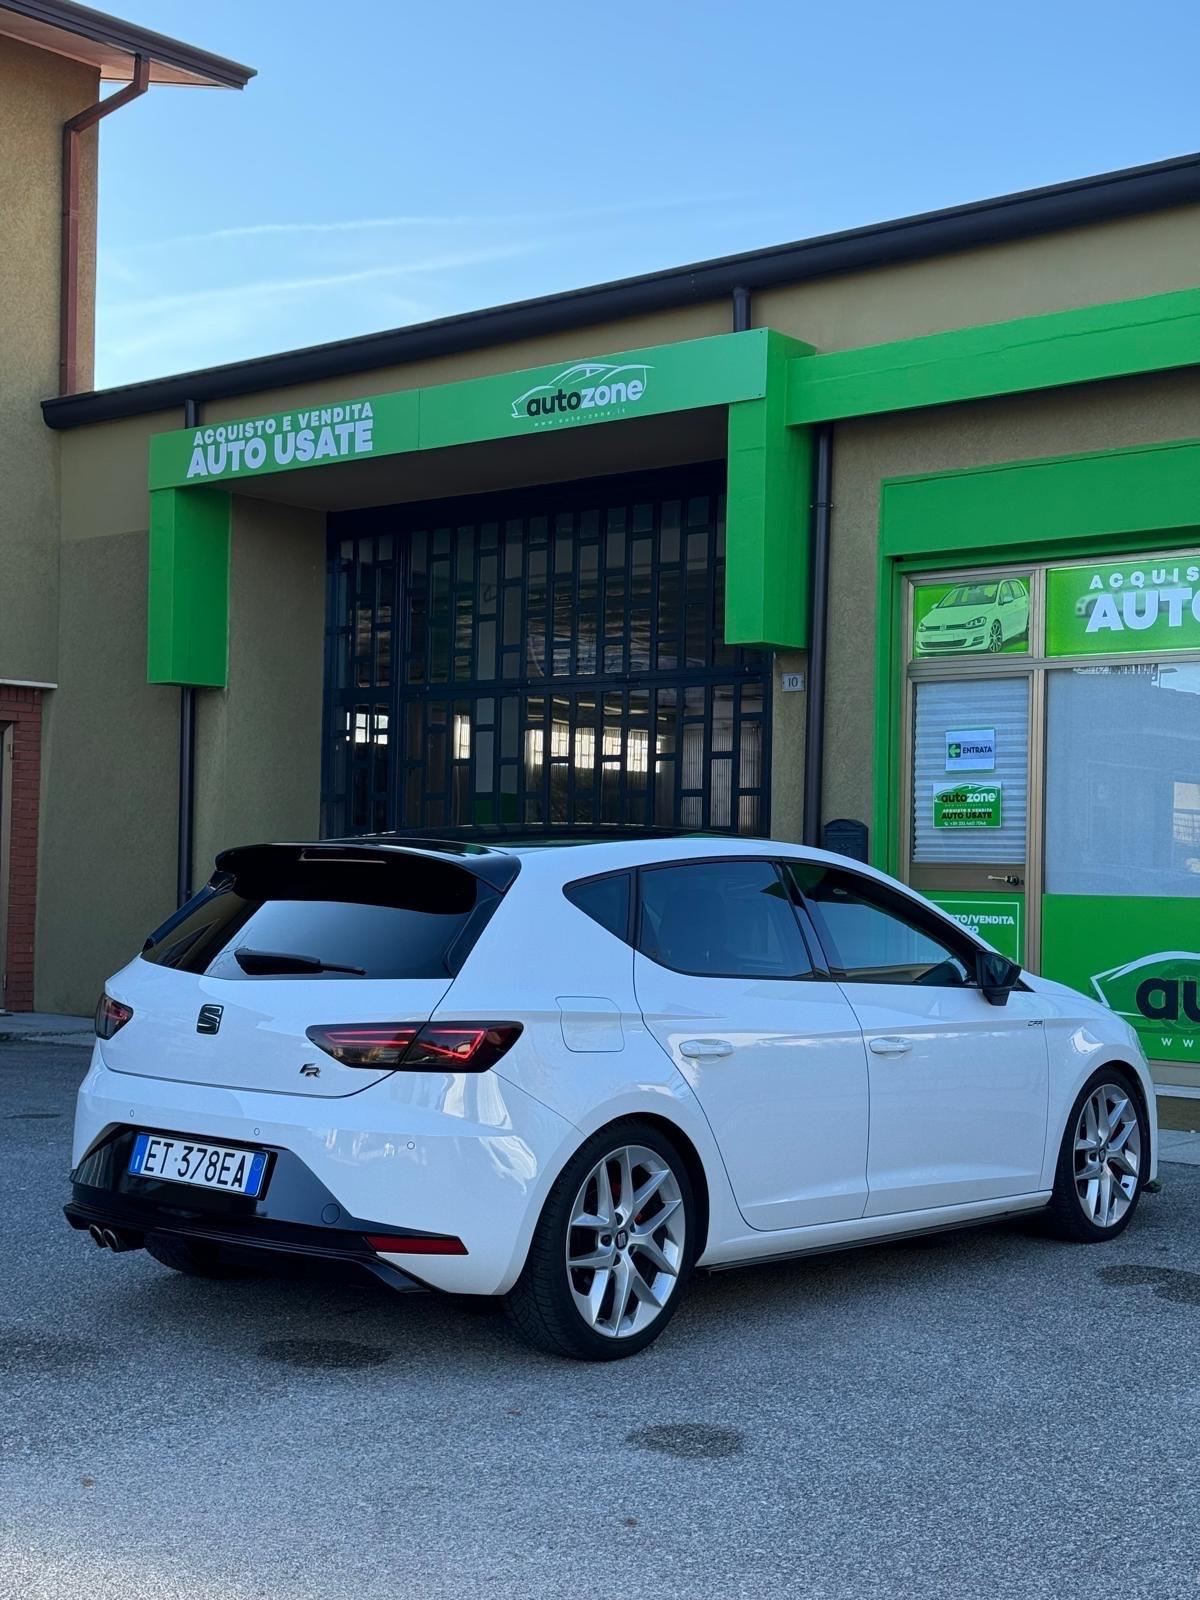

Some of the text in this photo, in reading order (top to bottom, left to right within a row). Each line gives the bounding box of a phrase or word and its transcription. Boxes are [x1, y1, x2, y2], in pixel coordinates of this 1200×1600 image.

[527, 380, 643, 416] autozone
[193, 402, 373, 446] ACQUISTO E VENDITA
[186, 419, 374, 478] AUTO USATE
[1089, 566, 1200, 589] ACQUIS
[1085, 587, 1200, 633] AUT
[787, 676, 798, 688] 10
[962, 746, 993, 755] ENTRATA
[941, 792, 997, 803] autozone
[941, 811, 964, 819] AUTO
[950, 914, 1015, 925] TO/VENDITA
[143, 1139, 246, 1188] ET 378EA
